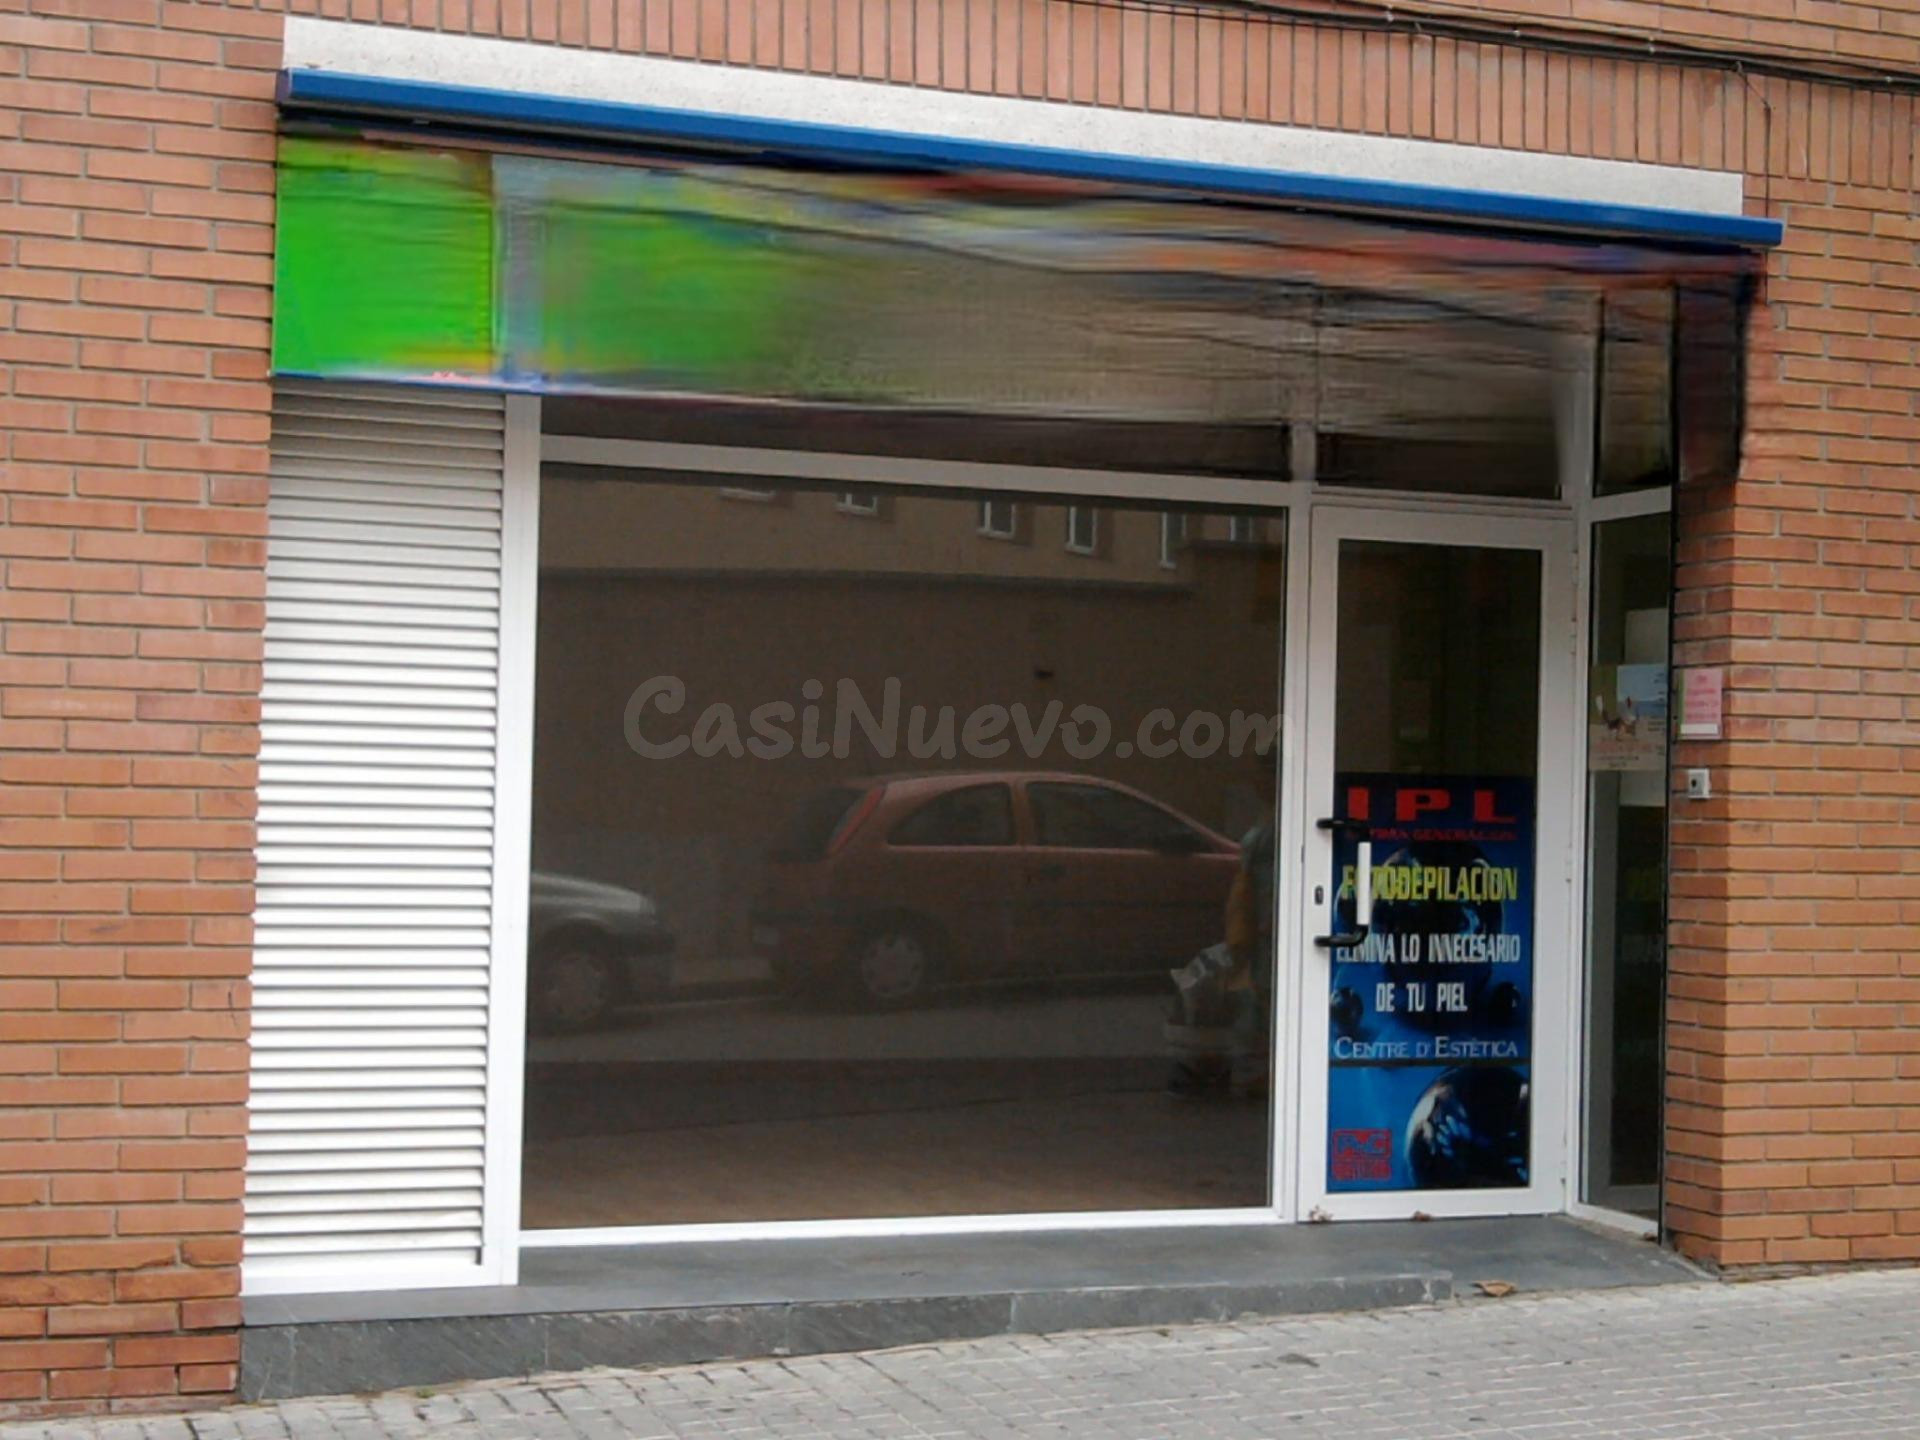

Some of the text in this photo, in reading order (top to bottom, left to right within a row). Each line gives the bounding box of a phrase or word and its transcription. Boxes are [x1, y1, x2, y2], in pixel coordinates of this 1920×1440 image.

[1348, 787, 1517, 823] IPL
[1342, 865, 1518, 901] FTODEPILACION
[1401, 933, 1421, 963] LO
[1428, 933, 1521, 963] INNECESARIO
[1376, 983, 1468, 1012] DE TU PIEL
